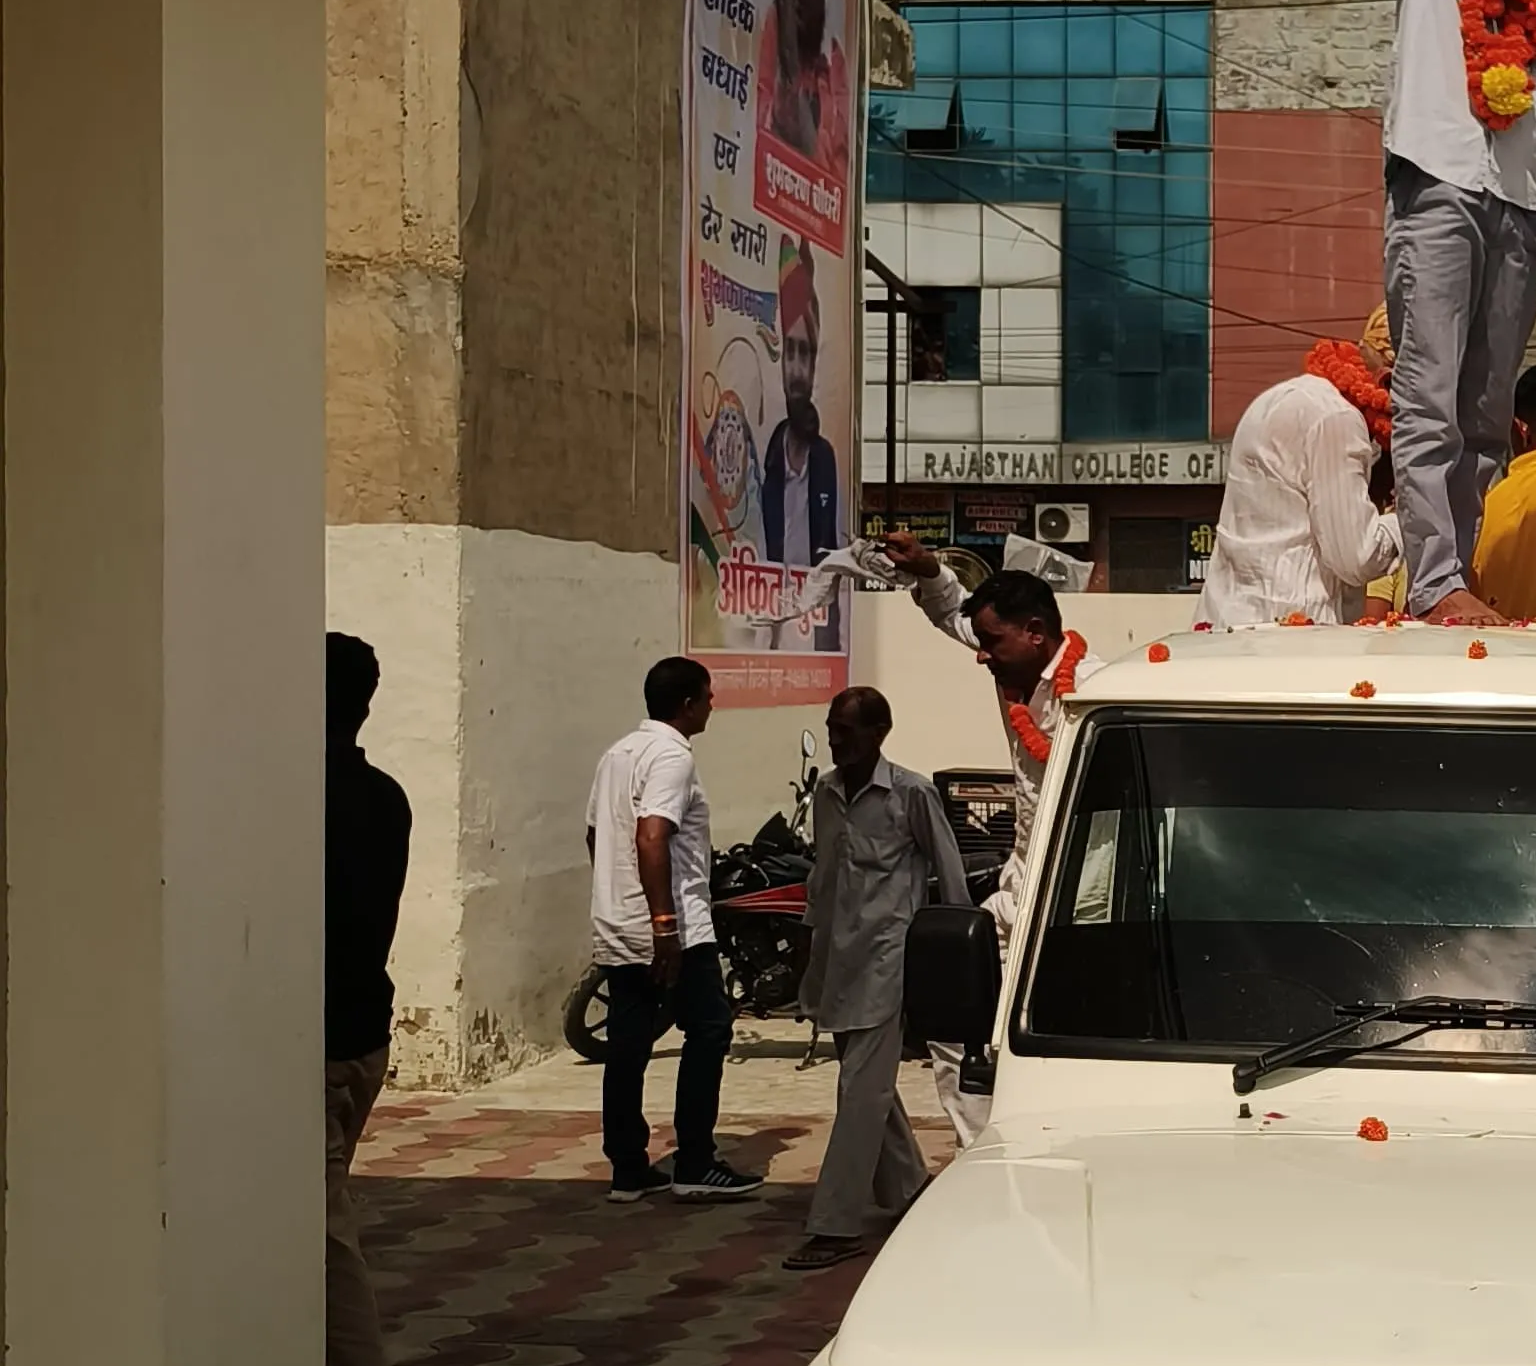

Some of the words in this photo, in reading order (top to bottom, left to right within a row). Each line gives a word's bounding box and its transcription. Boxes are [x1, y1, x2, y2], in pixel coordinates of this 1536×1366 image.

[701, 46, 753, 110] बधाई
[713, 131, 741, 176] एवं
[701, 194, 723, 244] ढेर
[730, 218, 768, 266] सारी
[923, 452, 1056, 478] RAJASTHAN
[1071, 452, 1169, 479] COLLEGE
[1188, 452, 1215, 478] OF
[718, 546, 784, 616] अंकित
